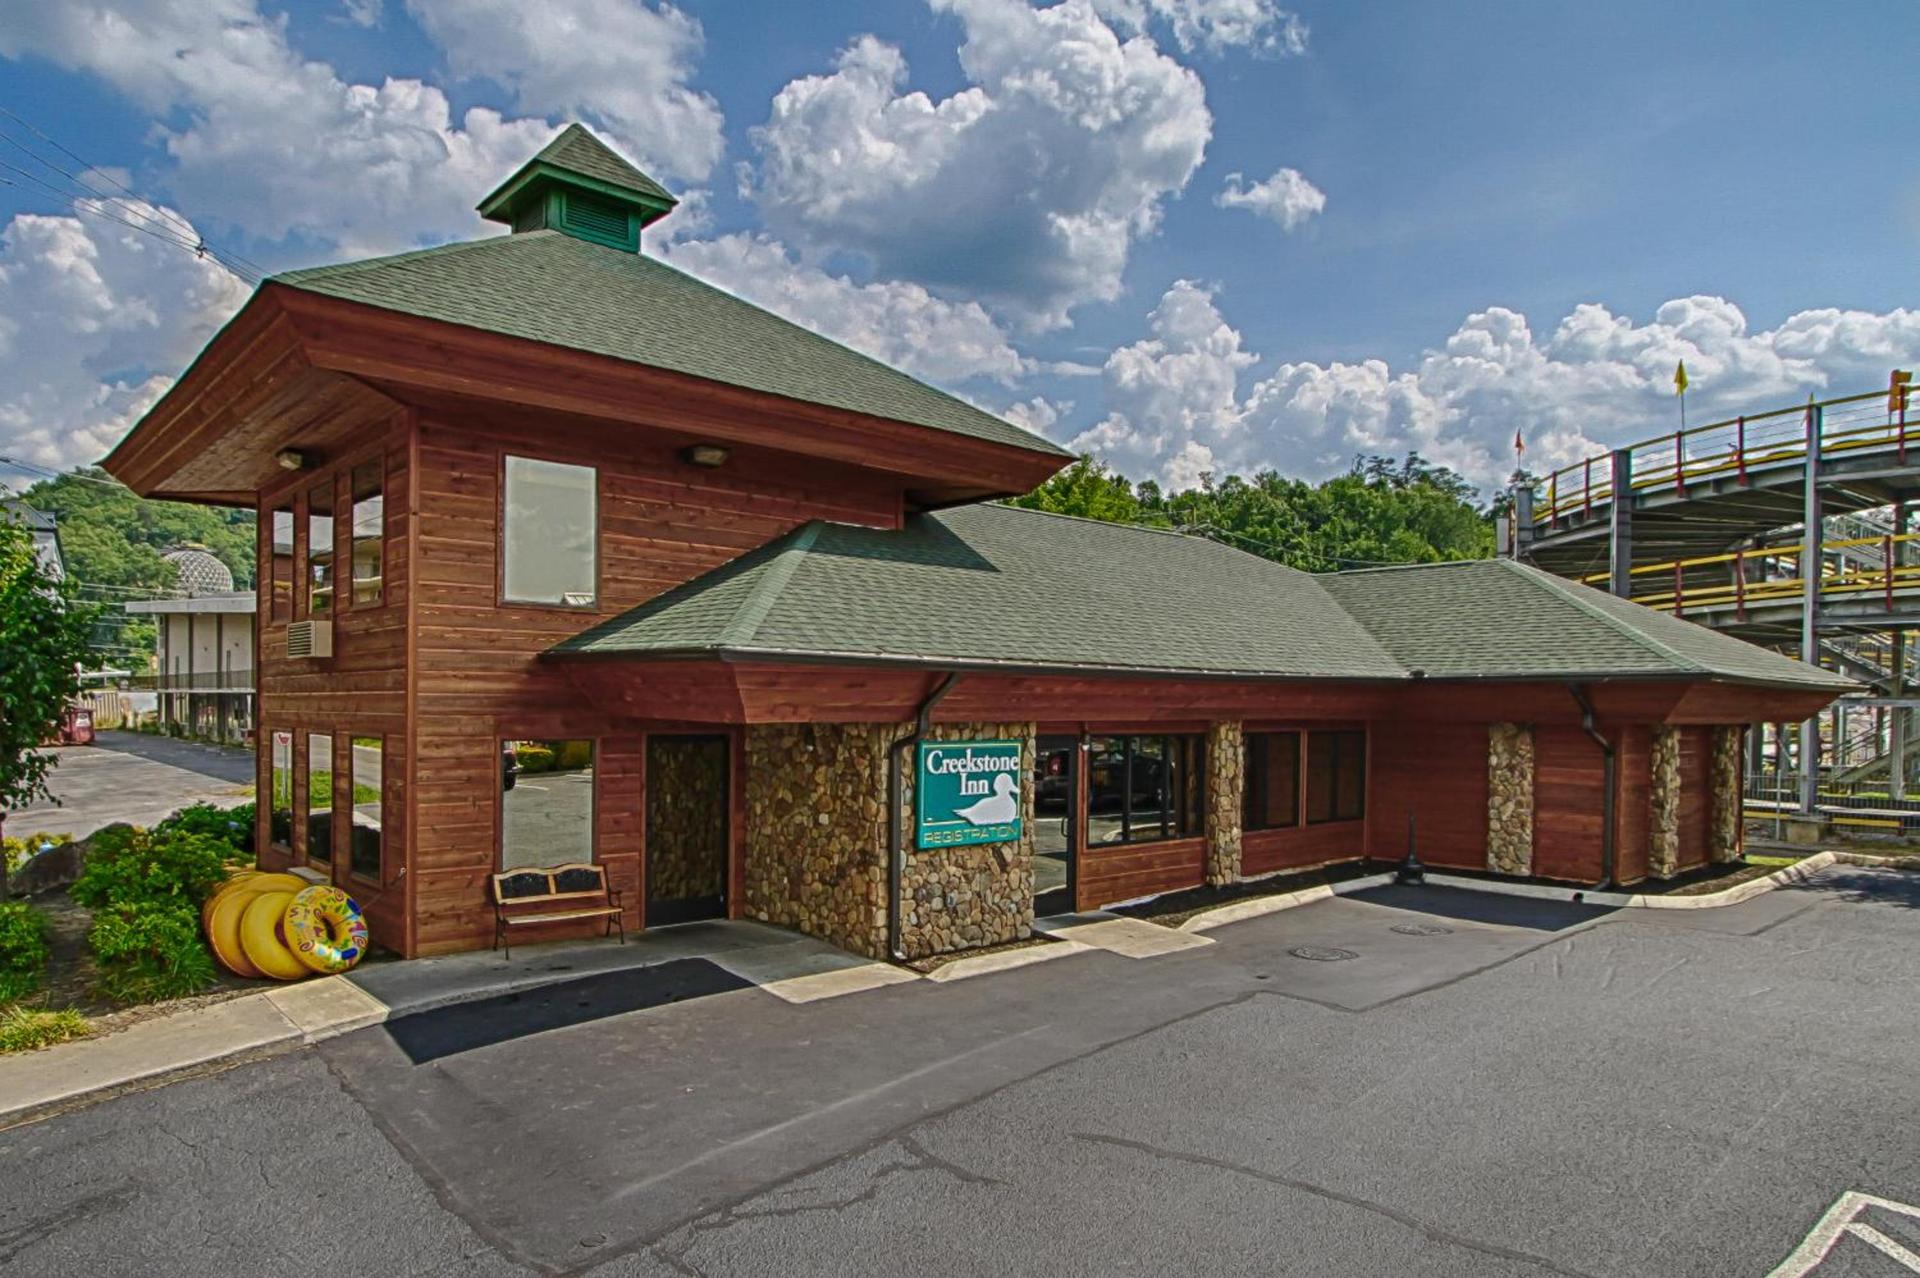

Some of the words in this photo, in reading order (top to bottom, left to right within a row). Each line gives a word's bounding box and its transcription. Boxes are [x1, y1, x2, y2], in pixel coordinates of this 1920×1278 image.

[926, 748, 1018, 774] Creekstone
[960, 772, 989, 795] Inn
[924, 826, 1017, 844] REGISTRATON
